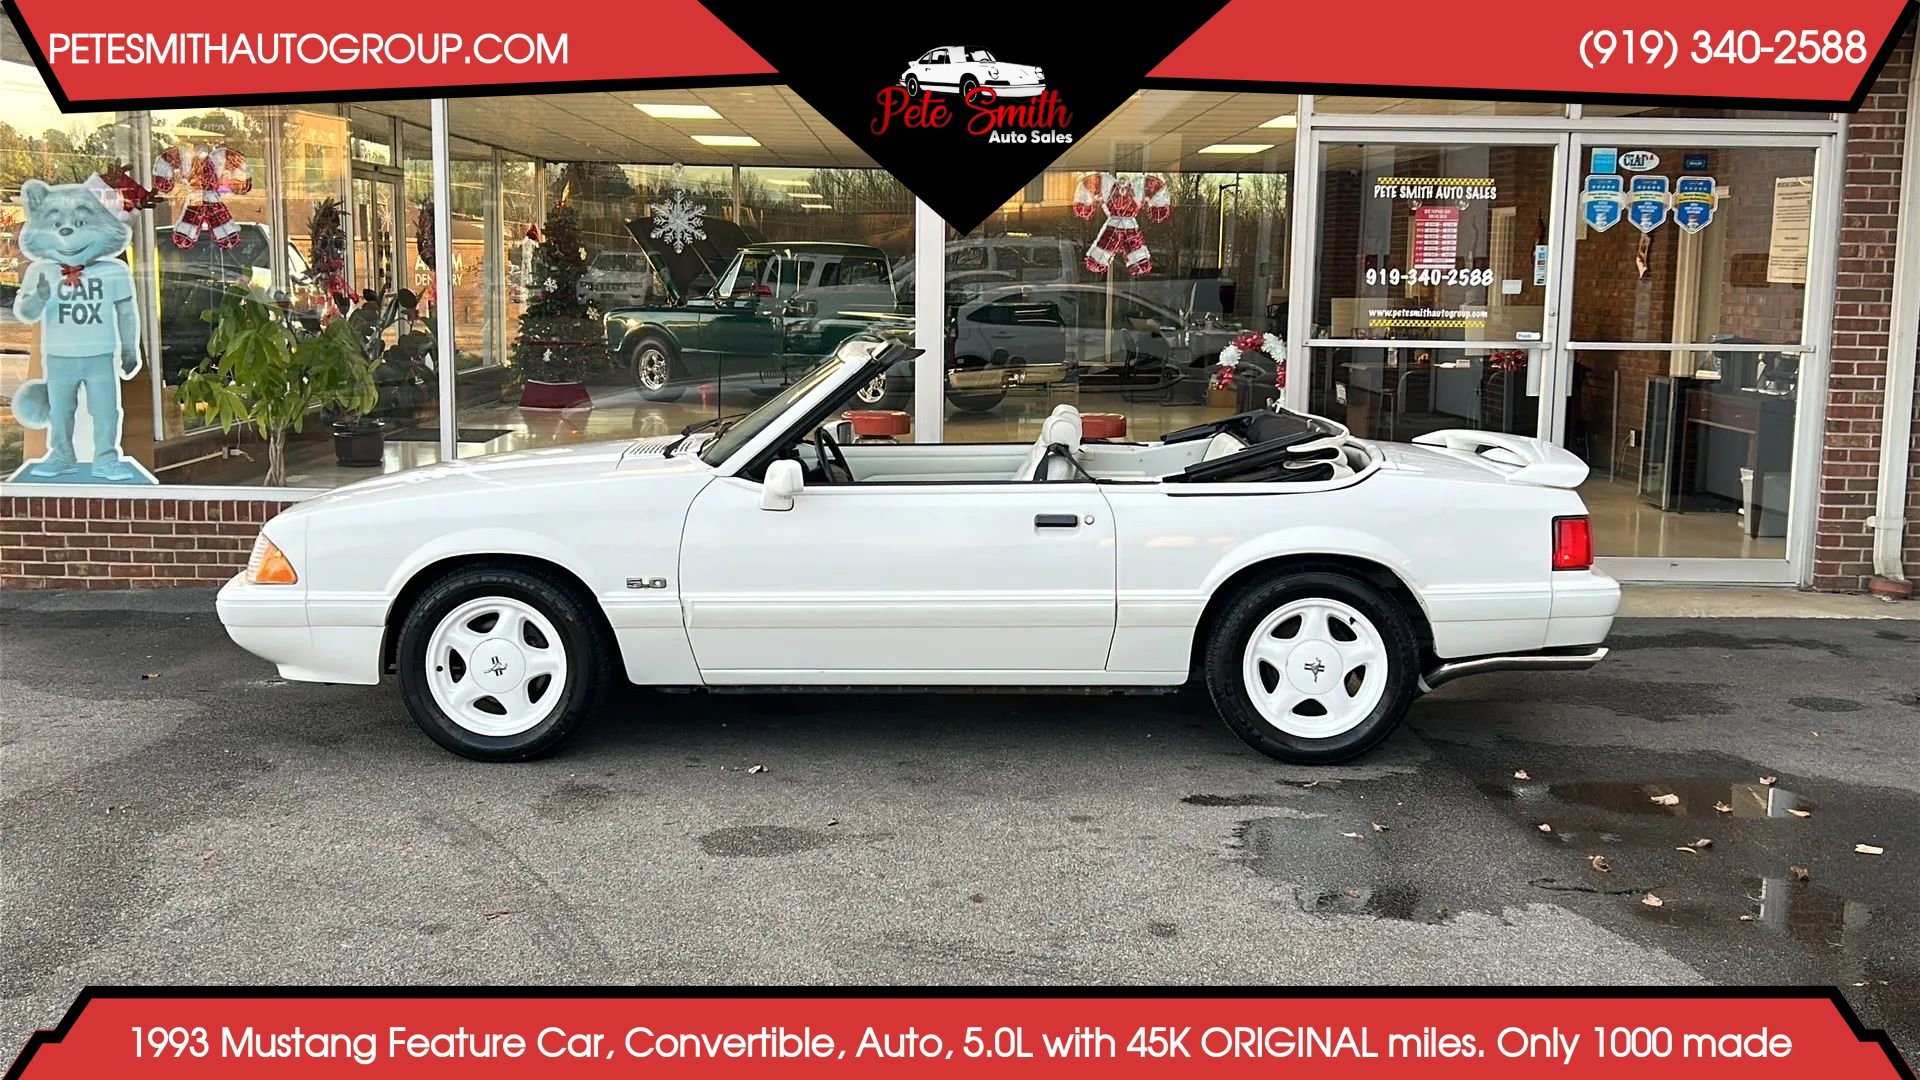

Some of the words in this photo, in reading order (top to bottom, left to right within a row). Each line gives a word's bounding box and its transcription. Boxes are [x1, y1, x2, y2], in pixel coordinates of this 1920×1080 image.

[1374, 185, 1398, 199] PETE
[1399, 185, 1434, 199] SMITH
[1435, 186, 1464, 199] AUTO
[1465, 186, 1497, 200] SALES
[1366, 268, 1495, 286] 919-340-2588
[57, 277, 104, 301] CAR
[58, 303, 104, 325] FOX
[1368, 307, 1488, 319] www.petesmithautogroup.com
[625, 577, 668, 589] 5.0
